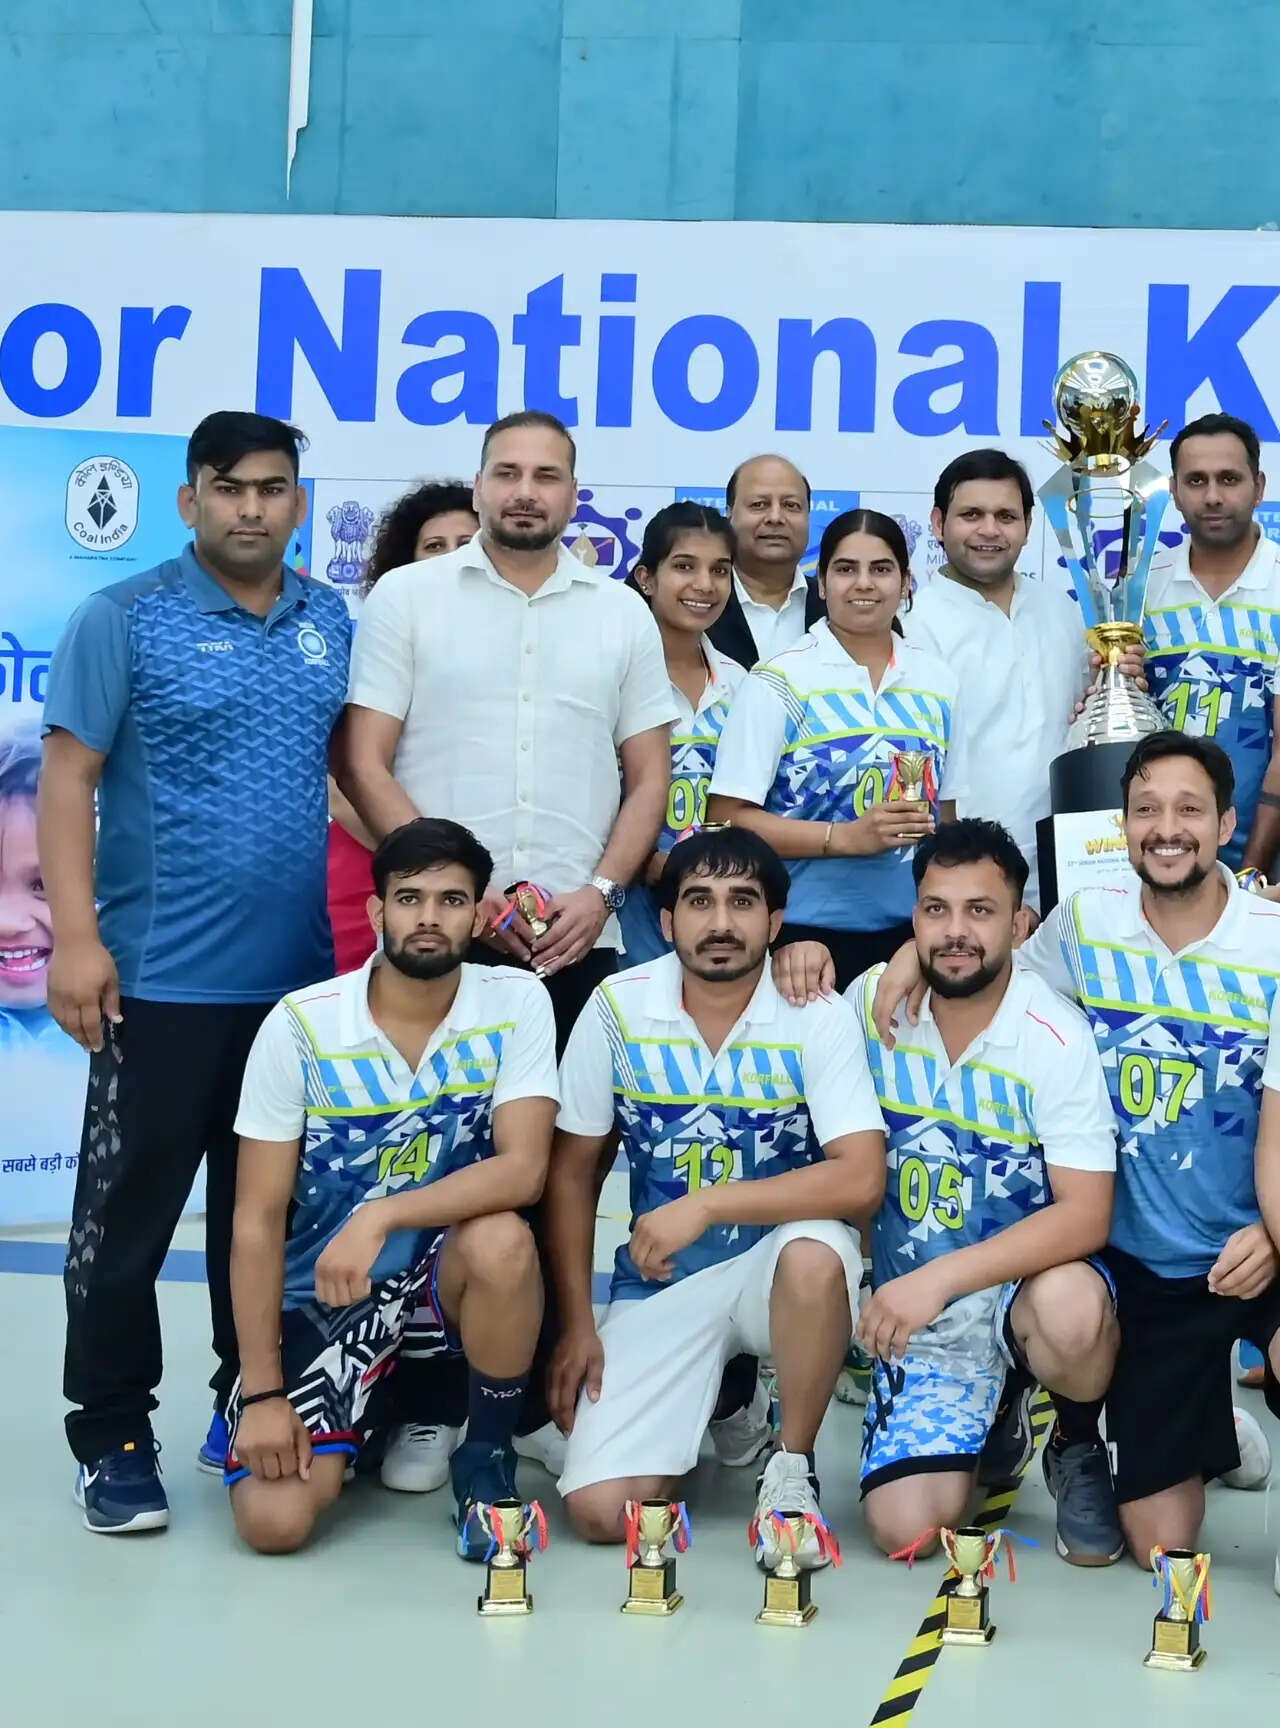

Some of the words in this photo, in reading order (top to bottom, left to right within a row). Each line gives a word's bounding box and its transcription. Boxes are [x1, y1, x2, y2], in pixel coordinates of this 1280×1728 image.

[255, 266, 1062, 437] National
[73, 521, 97, 544] Coal
[100, 524, 128, 544] India
[1163, 681, 1223, 737] 11
[1119, 1053, 1196, 1123] 07
[2, 1155, 36, 1173] सबसे
[40, 1152, 63, 1174] बड़ी
[674, 1141, 734, 1193] 12
[898, 1156, 965, 1230] 05
